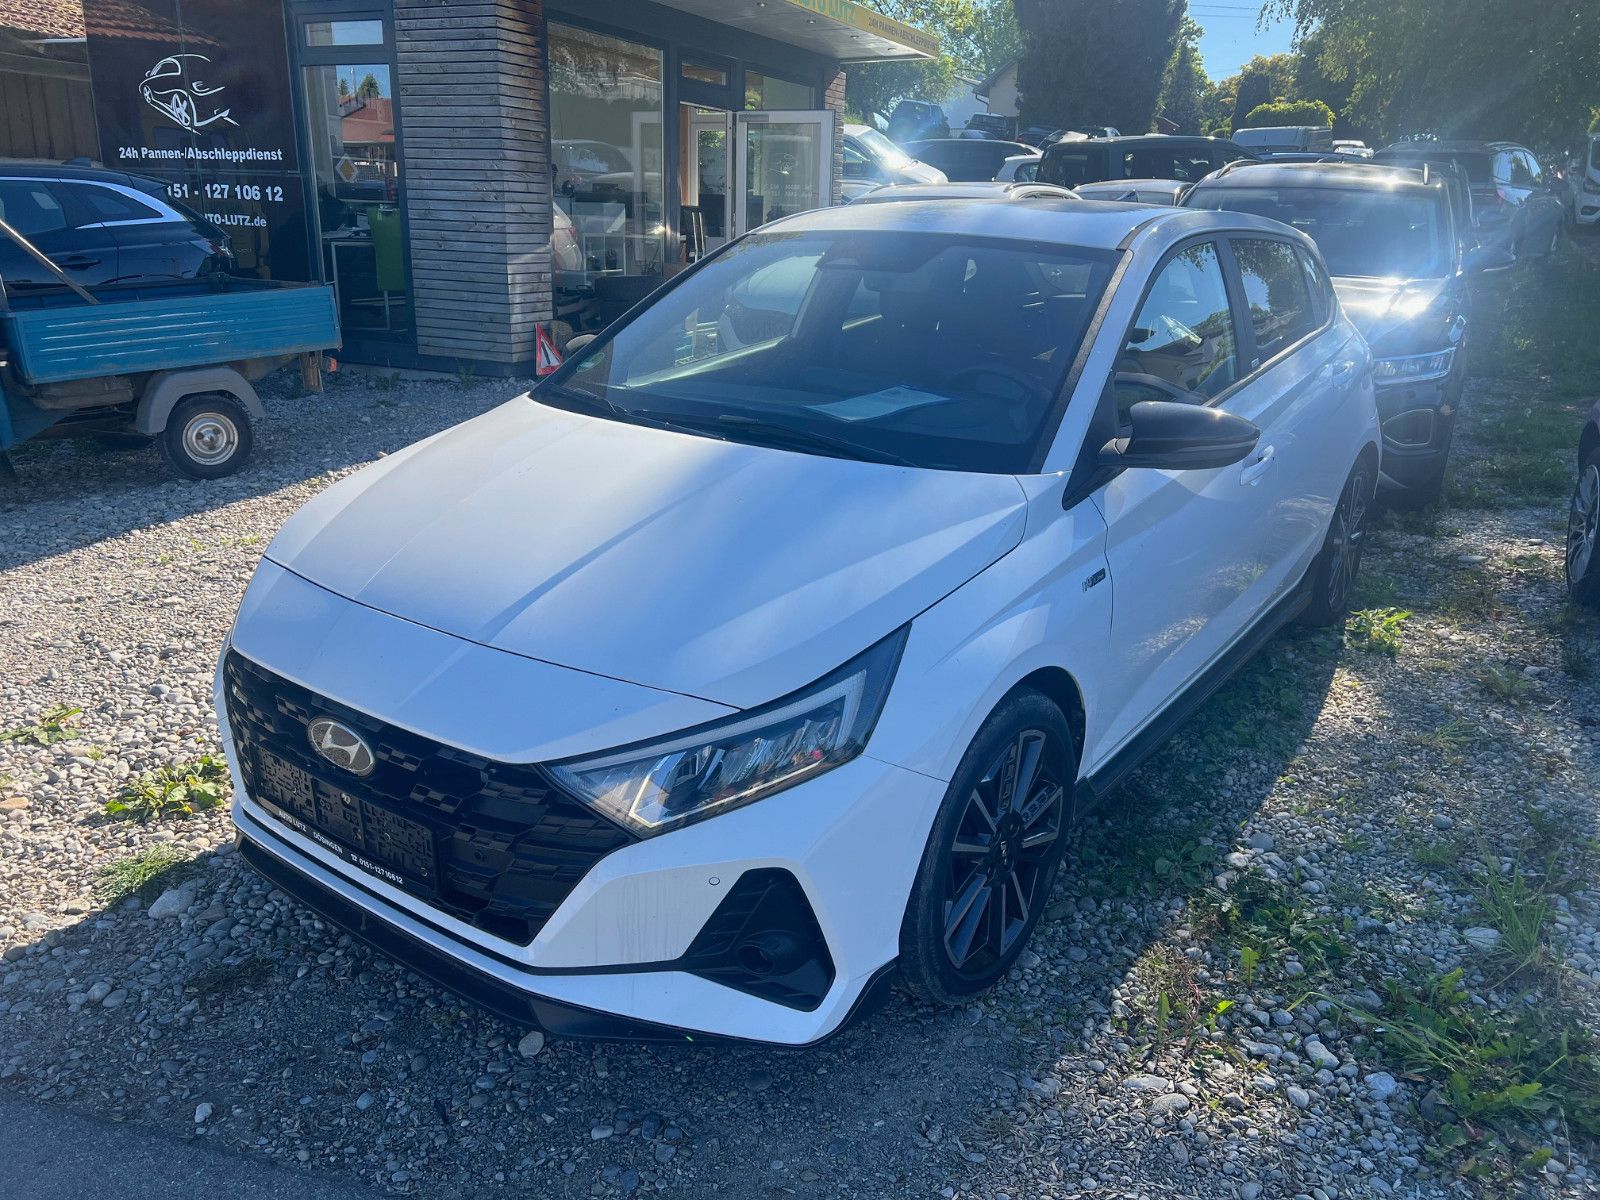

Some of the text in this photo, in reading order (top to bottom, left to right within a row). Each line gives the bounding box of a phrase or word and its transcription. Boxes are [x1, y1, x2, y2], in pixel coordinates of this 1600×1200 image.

[118, 147, 283, 163] 24h Pannen-/Abschleppdienst
[167, 183, 189, 198] 151
[204, 183, 229, 199] 127
[234, 185, 261, 201] 106
[265, 186, 284, 202] 12
[205, 213, 267, 228] TO-LUTZ.de
